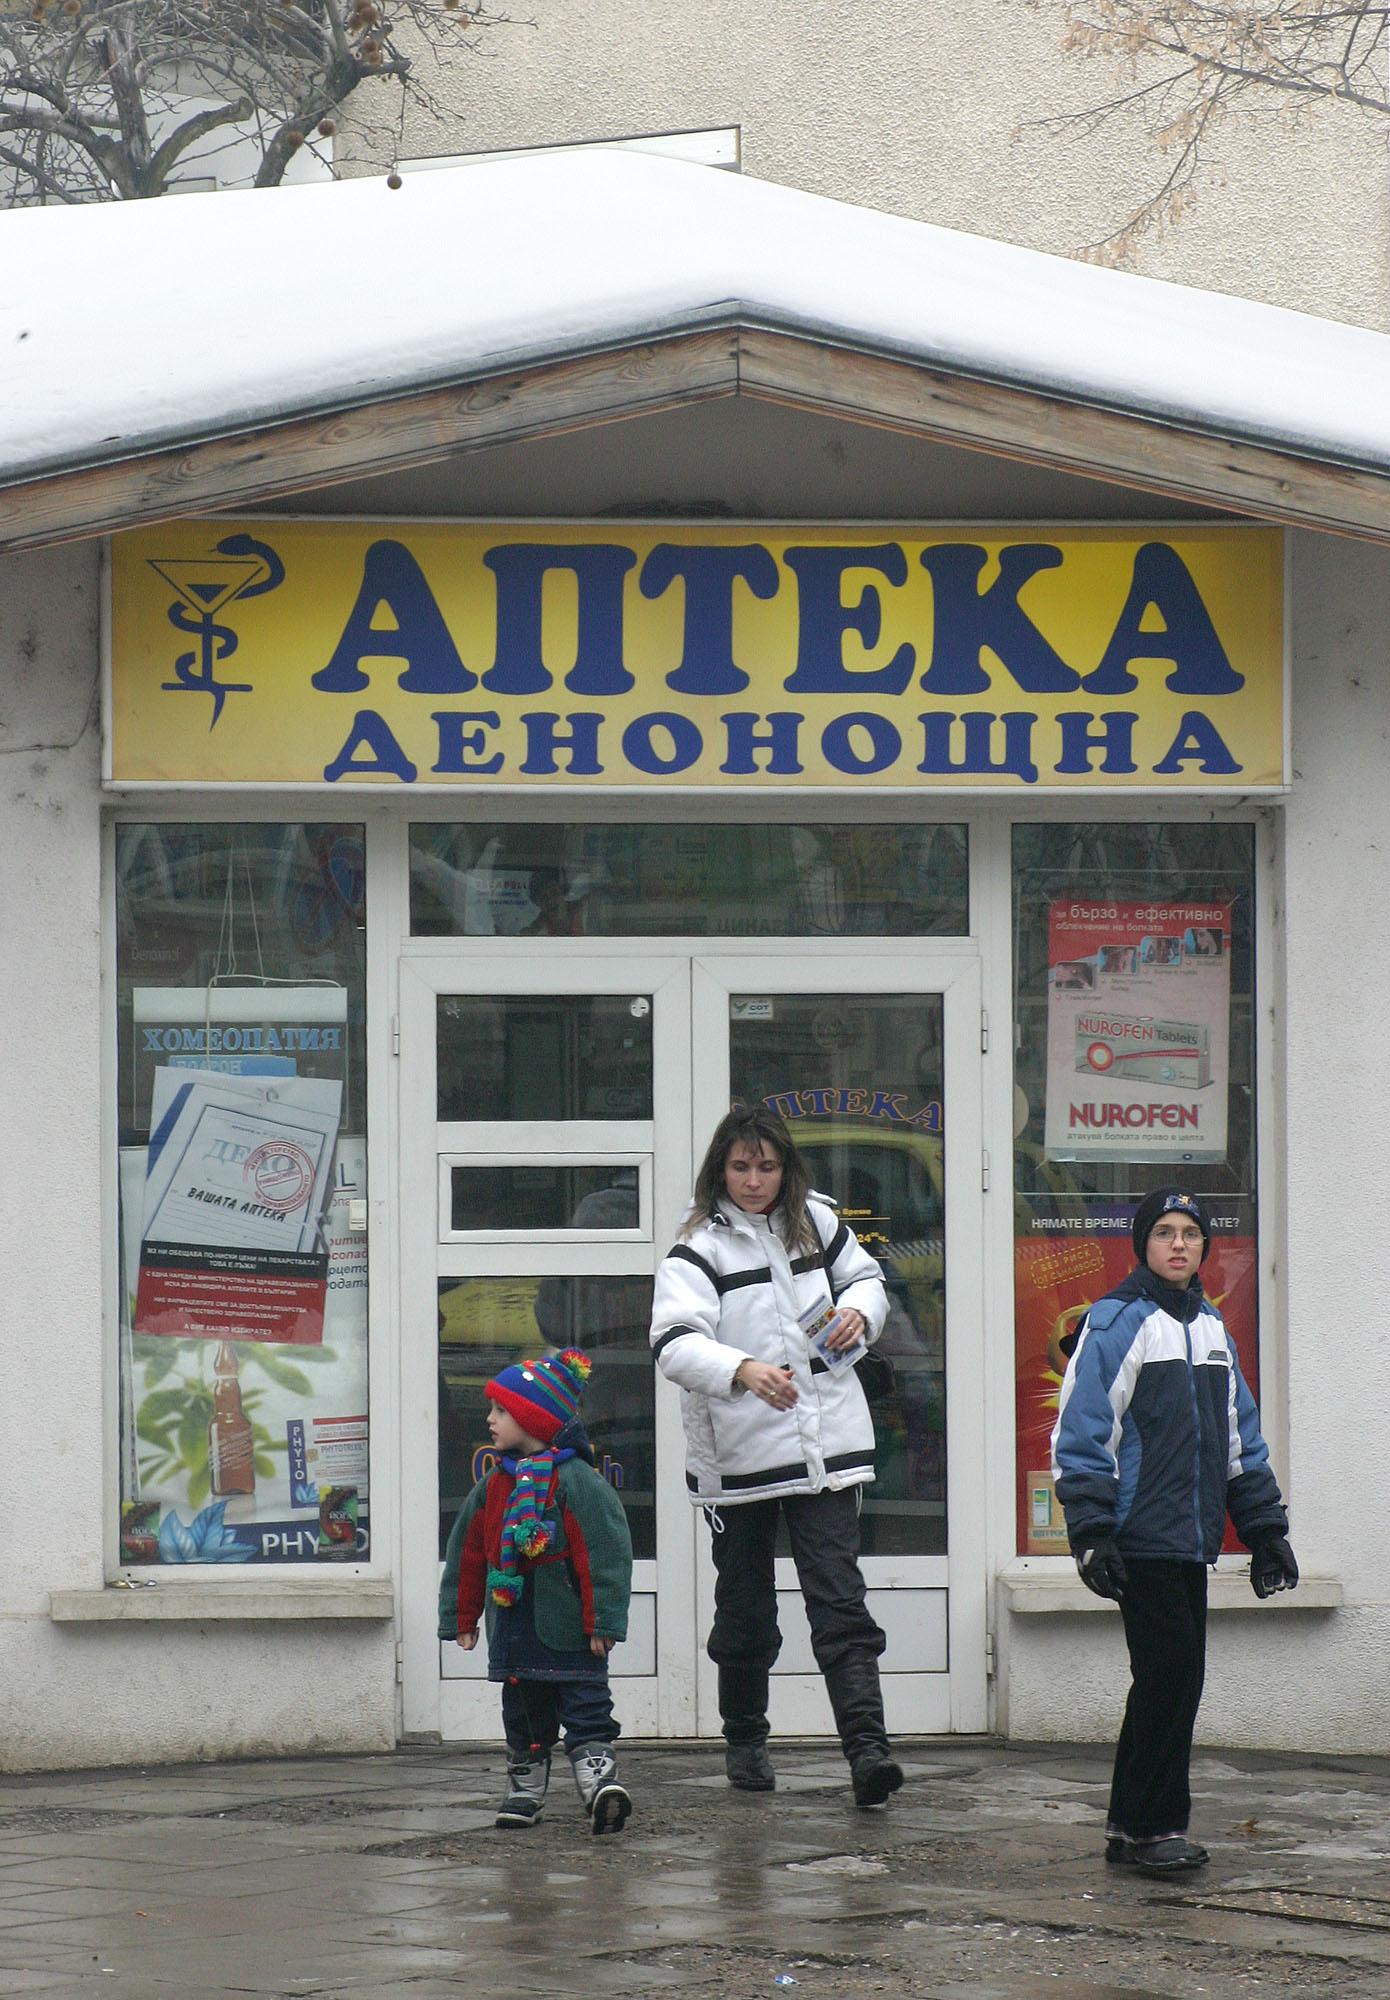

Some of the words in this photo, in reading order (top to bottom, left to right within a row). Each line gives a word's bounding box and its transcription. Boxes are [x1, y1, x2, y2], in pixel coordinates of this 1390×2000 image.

[311, 539, 1246, 696] АПТЕКА
[323, 709, 1244, 783] ДЕНОНОЩНА
[1070, 905, 1118, 921] бързо
[1135, 907, 1223, 923] ефективно
[1126, 922, 1163, 932] болката
[143, 1028, 342, 1051] ХОМЕОПАТИЯ
[1077, 1017, 1153, 1041] NUROFEN
[1155, 1029, 1198, 1045] Tablets
[731, 1088, 942, 1132] ПТЕКА
[1069, 1102, 1199, 1129] NUROFEN
[1067, 1132, 1102, 1141] атакува
[1103, 1131, 1140, 1141] болката
[1142, 1133, 1169, 1142] право
[187, 1188, 236, 1210] ВАШАТА
[240, 1201, 287, 1223] АПТЕКА
[1031, 1218, 1082, 1229] НЯМАТЕ
[1084, 1218, 1128, 1229] ВРЕМЕ
[1209, 1217, 1240, 1228] АТЕ?
[168, 1249, 203, 1257] ОБЕЩАВА
[327, 1250, 368, 1260] сопад
[293, 1426, 305, 1480] PHYTO
[262, 1527, 369, 1556] PHYO
